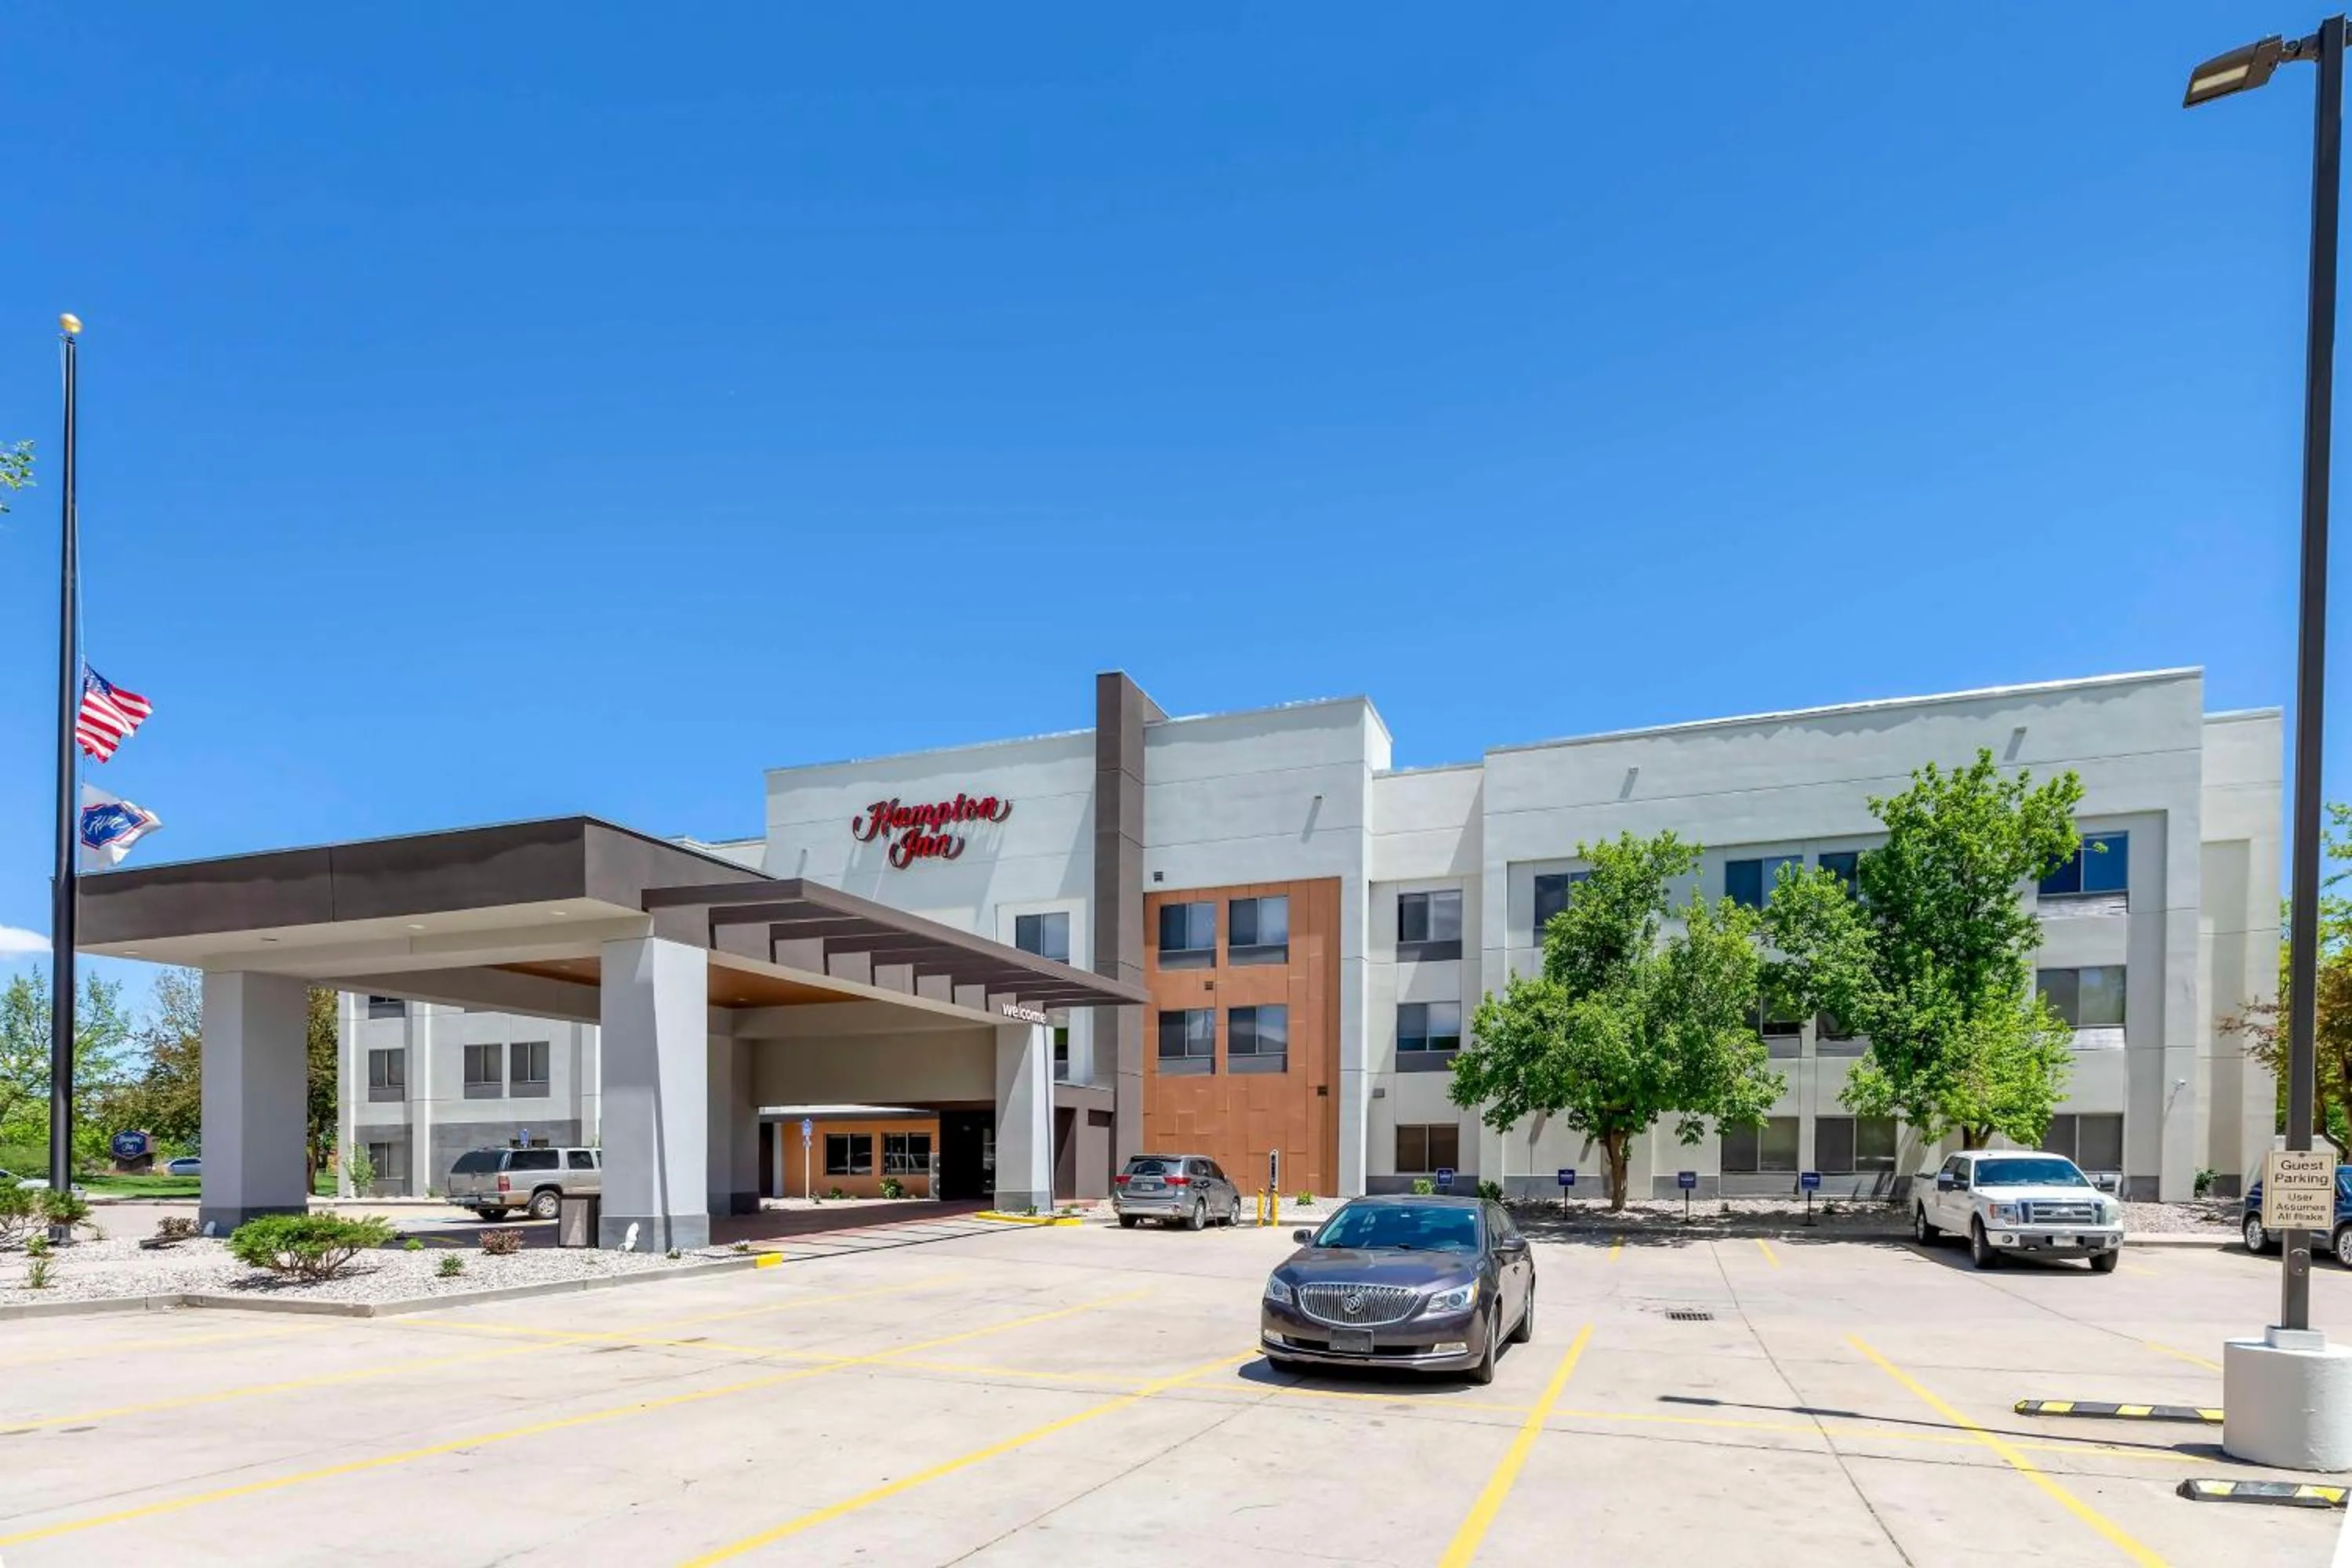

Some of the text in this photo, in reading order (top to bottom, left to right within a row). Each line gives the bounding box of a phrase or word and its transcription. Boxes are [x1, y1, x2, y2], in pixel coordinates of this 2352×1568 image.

[853, 793, 1013, 842] Hampton
[889, 828, 965, 870] Inn
[2281, 1160, 2324, 1171] Guest
[2274, 1173, 2329, 1186] Parking
